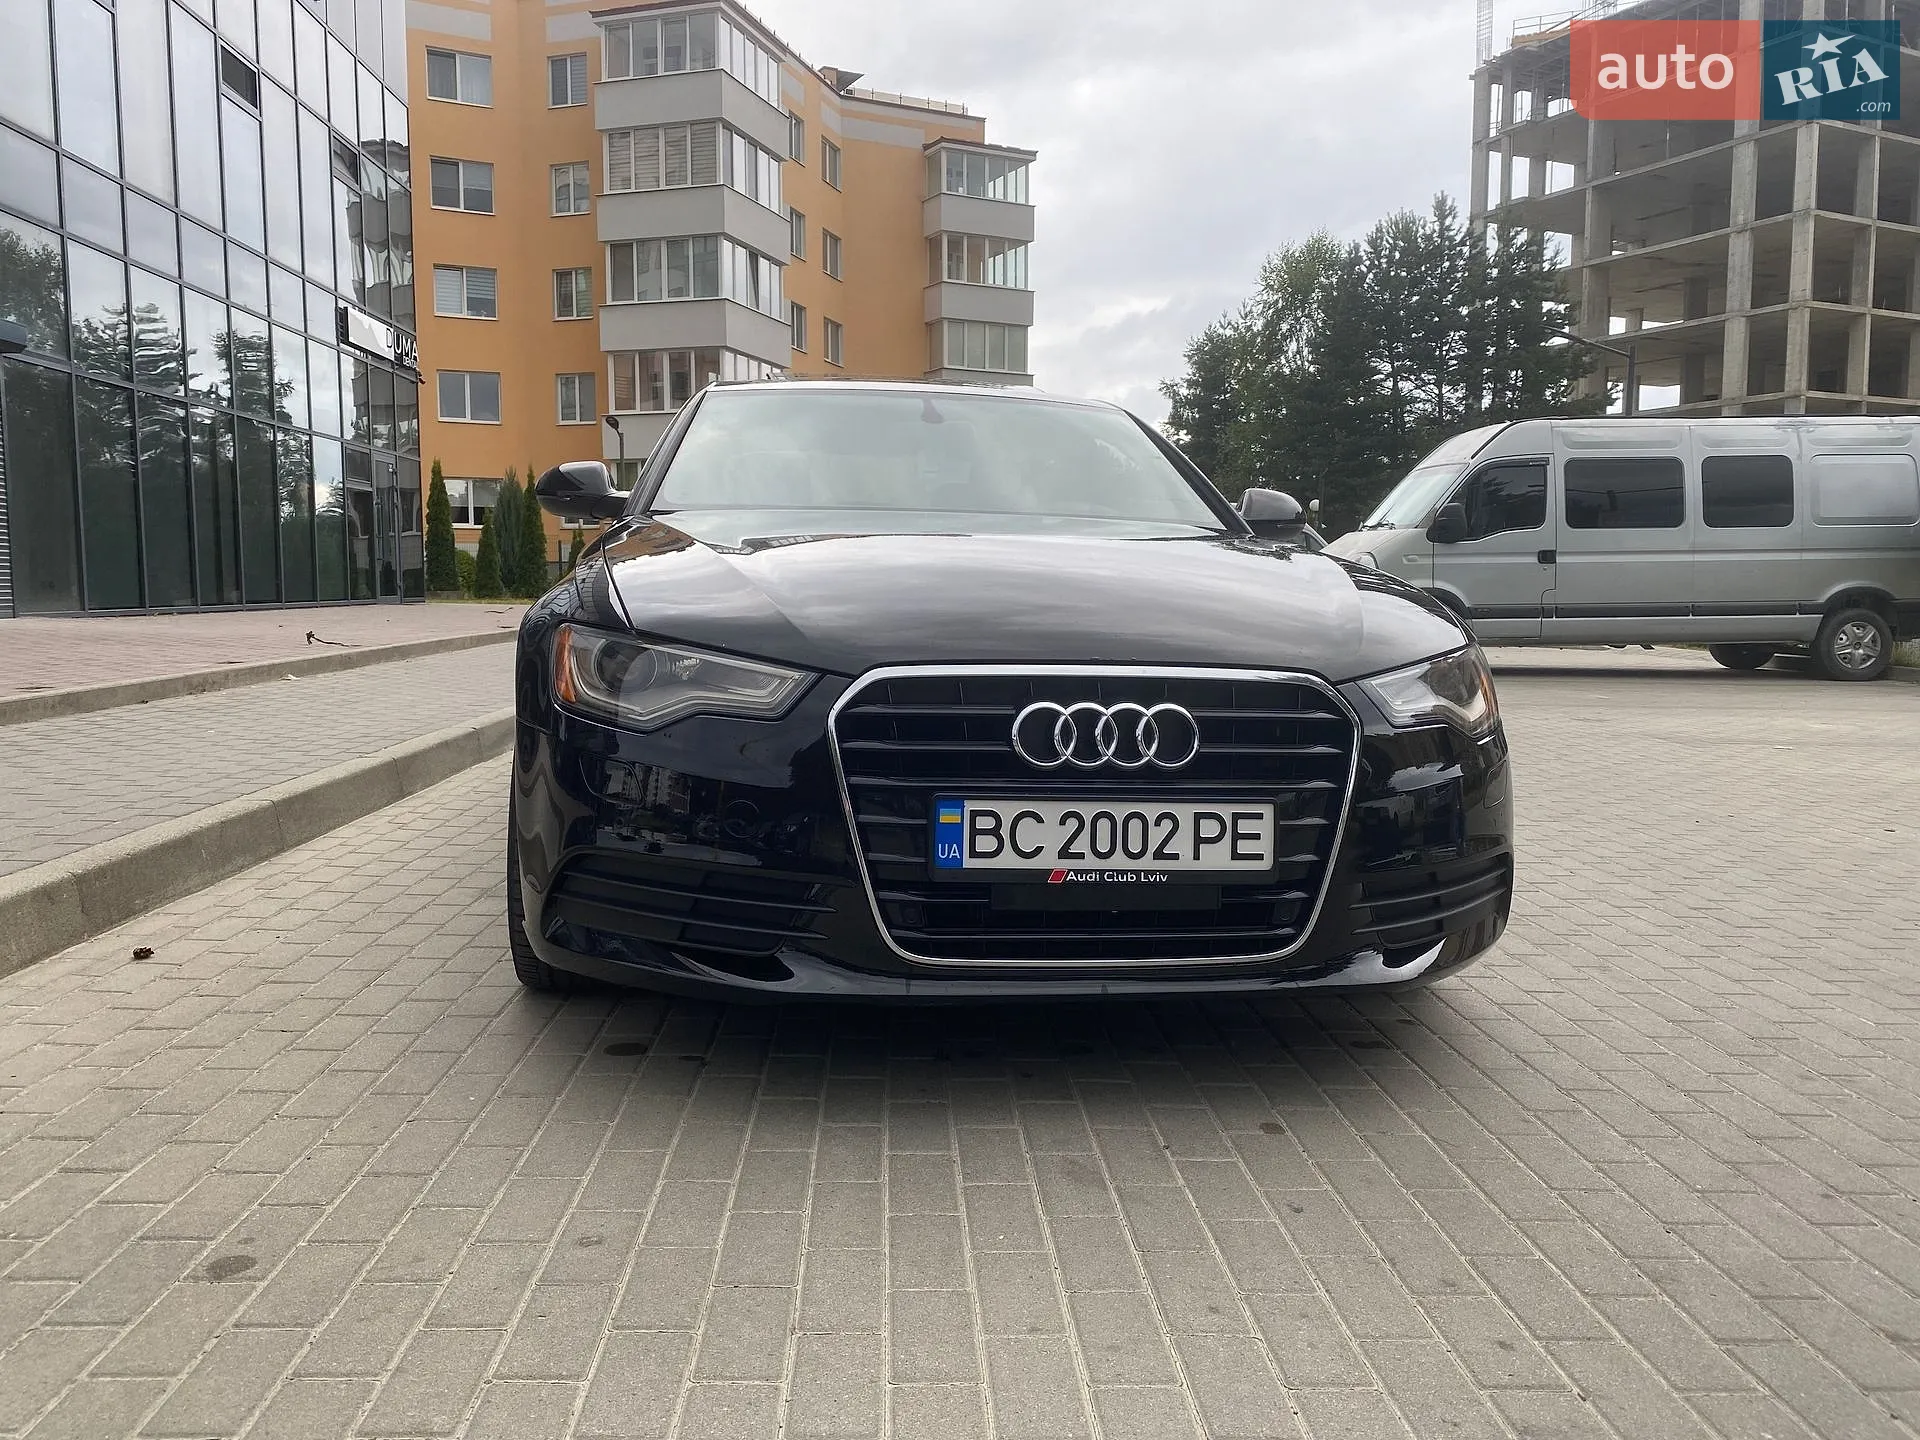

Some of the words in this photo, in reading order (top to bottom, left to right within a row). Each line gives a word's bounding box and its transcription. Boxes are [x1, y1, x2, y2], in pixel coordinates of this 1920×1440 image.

[968, 808, 1045, 860] BC
[1057, 809, 1180, 861] 2002
[1192, 811, 1265, 861] PE
[938, 843, 960, 859] UA
[1066, 871, 1100, 882] Audi
[1104, 871, 1137, 882] Club
[1140, 871, 1169, 882] Lviv
